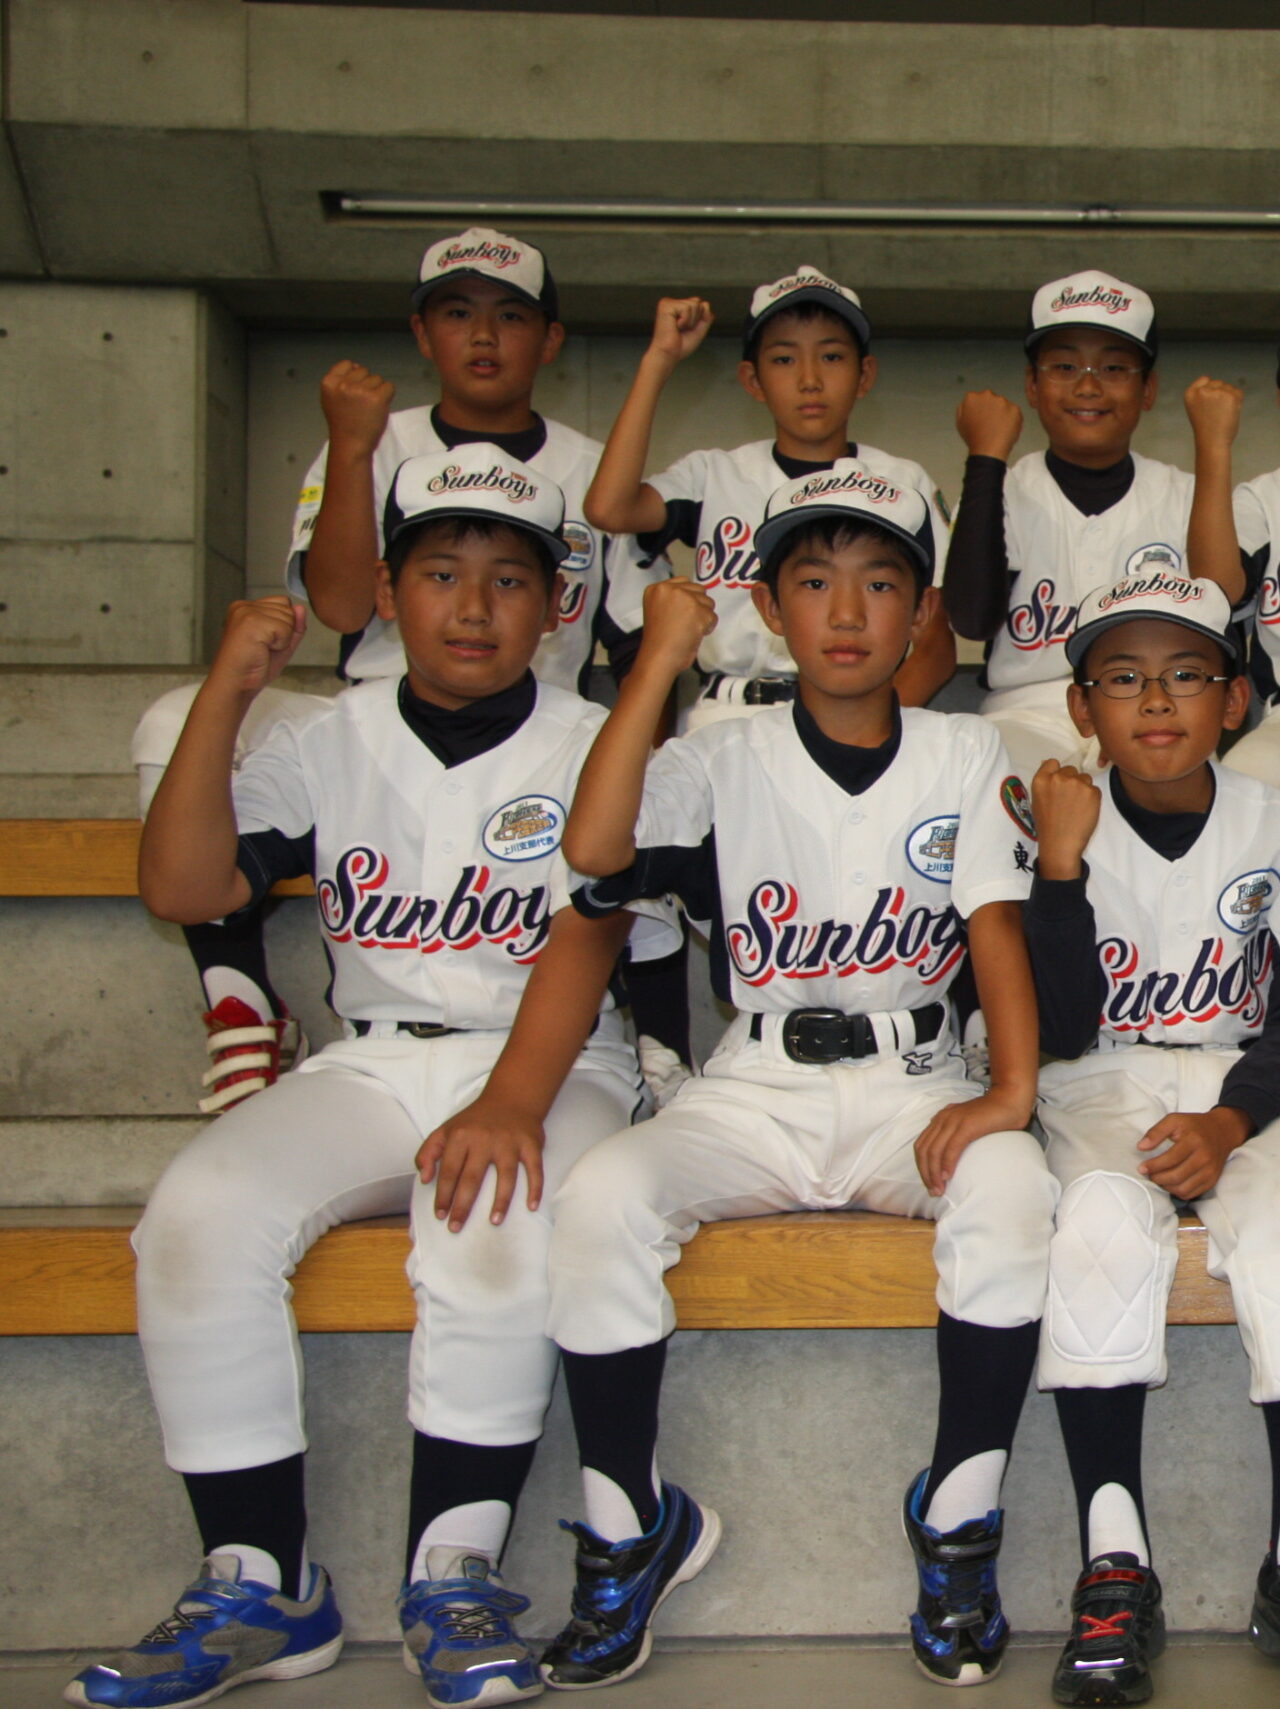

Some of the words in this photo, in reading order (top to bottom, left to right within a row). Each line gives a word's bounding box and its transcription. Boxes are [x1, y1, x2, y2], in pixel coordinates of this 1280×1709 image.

[437, 241, 521, 269] Sunboys
[1050, 286, 1132, 315] Sunboys
[427, 464, 539, 503] Sunboys
[790, 471, 902, 504] Sunboys
[1097, 571, 1205, 613] Sunboys
[1012, 840, 1034, 873] 東
